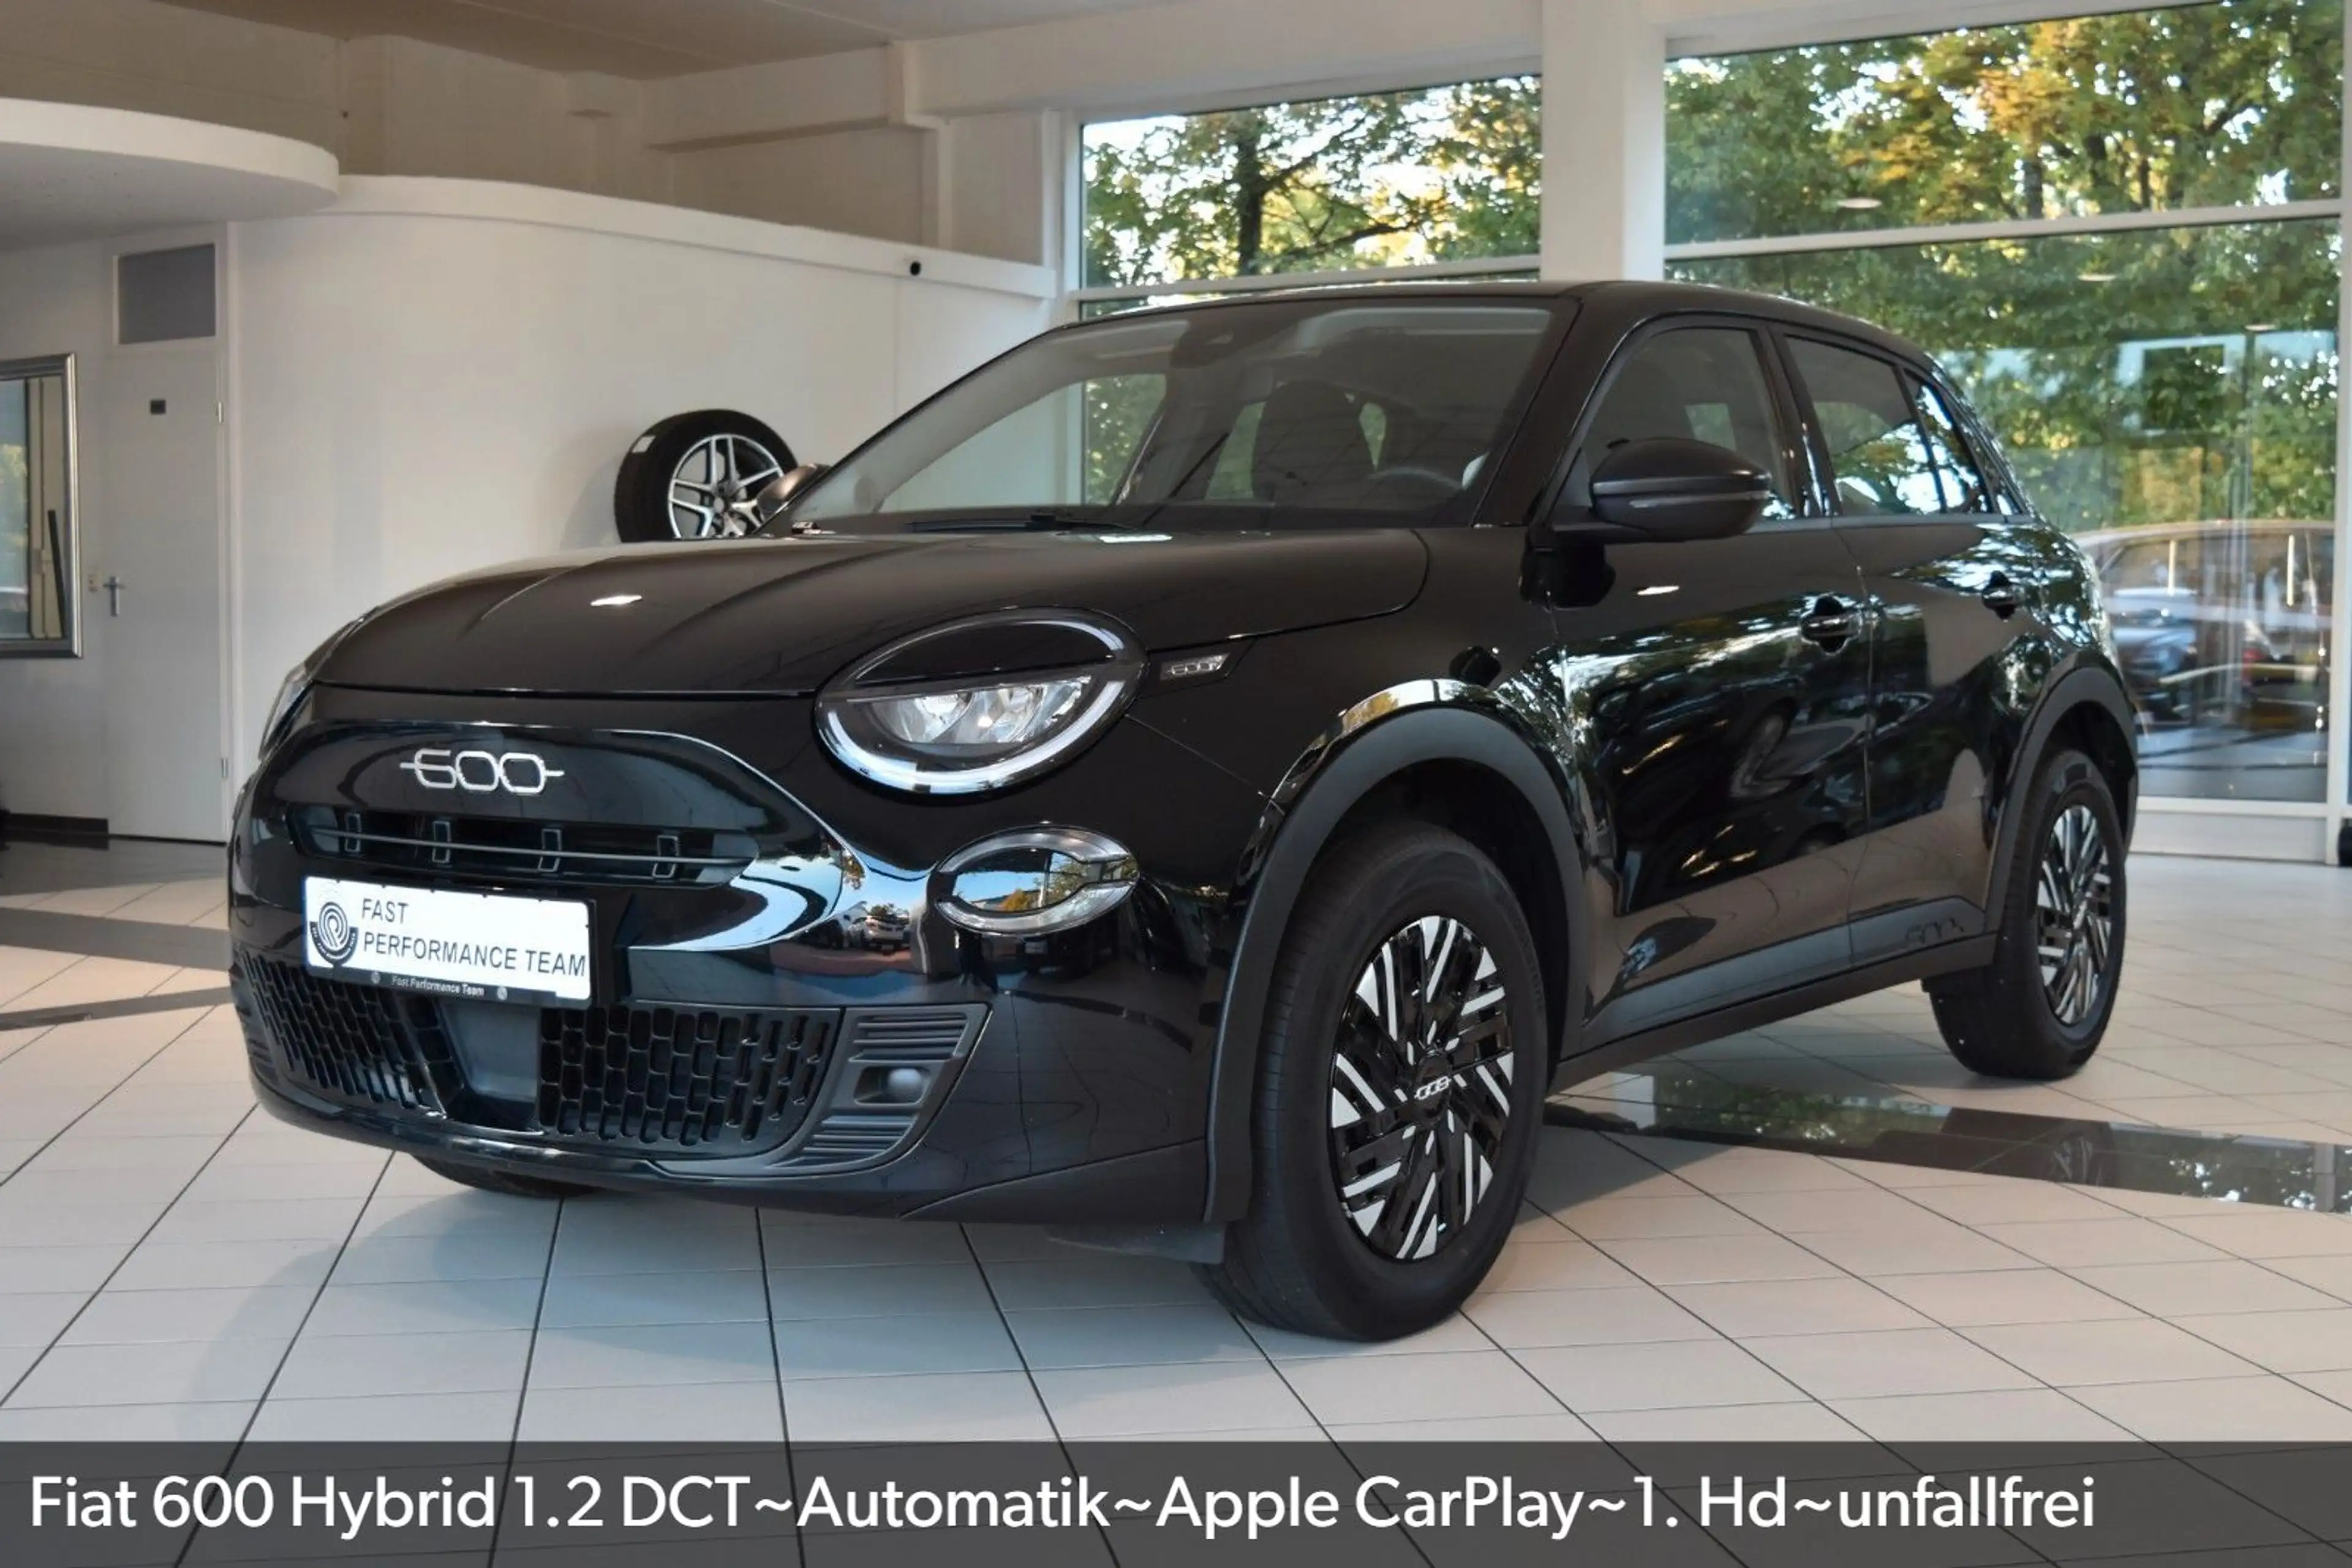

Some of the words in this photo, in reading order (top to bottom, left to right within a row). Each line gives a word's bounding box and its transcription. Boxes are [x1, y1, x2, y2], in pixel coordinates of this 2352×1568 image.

[400, 748, 565, 793] 600
[361, 897, 409, 924] FAST
[363, 931, 518, 970] PERFORMANCE
[525, 948, 586, 977] TEAM
[391, 975, 410, 986] Fast
[410, 978, 460, 994] Performance
[462, 982, 485, 997] Team
